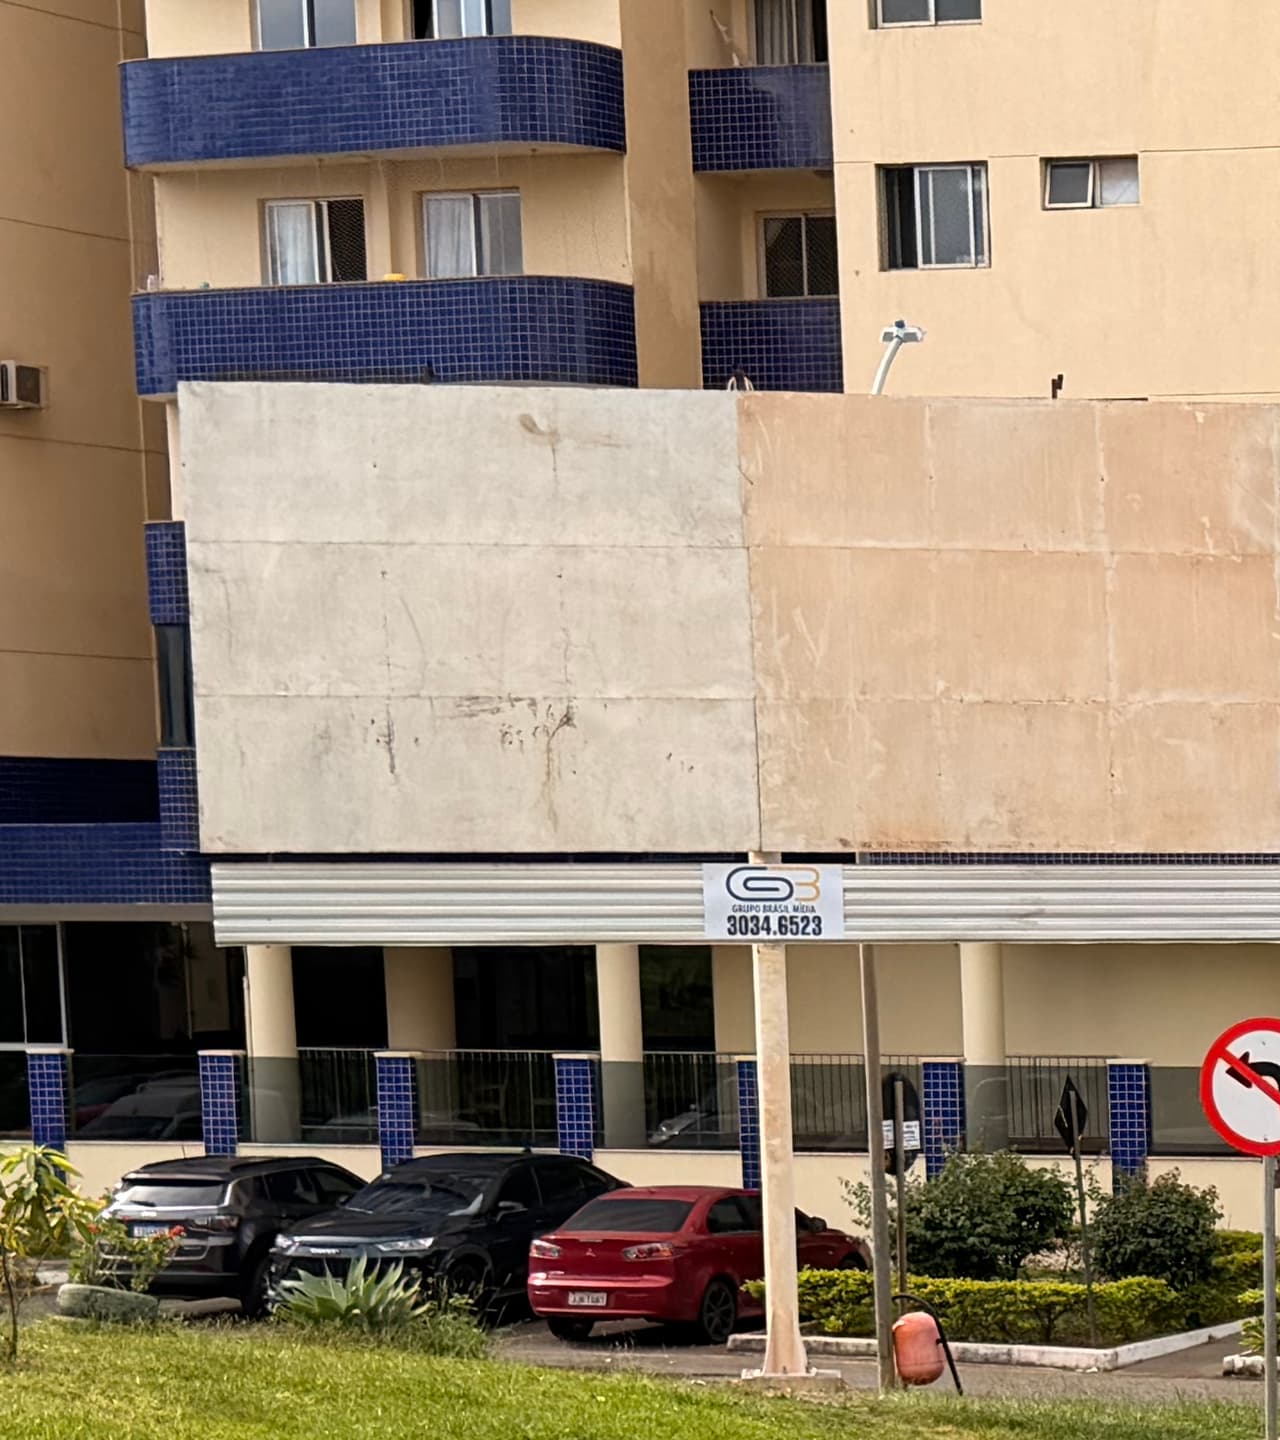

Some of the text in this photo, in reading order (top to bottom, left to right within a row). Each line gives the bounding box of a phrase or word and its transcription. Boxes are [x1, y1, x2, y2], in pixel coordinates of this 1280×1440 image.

[732, 904, 761, 914] GRUPO
[762, 904, 789, 914] BRASIL
[727, 915, 822, 936] 3034.6523
